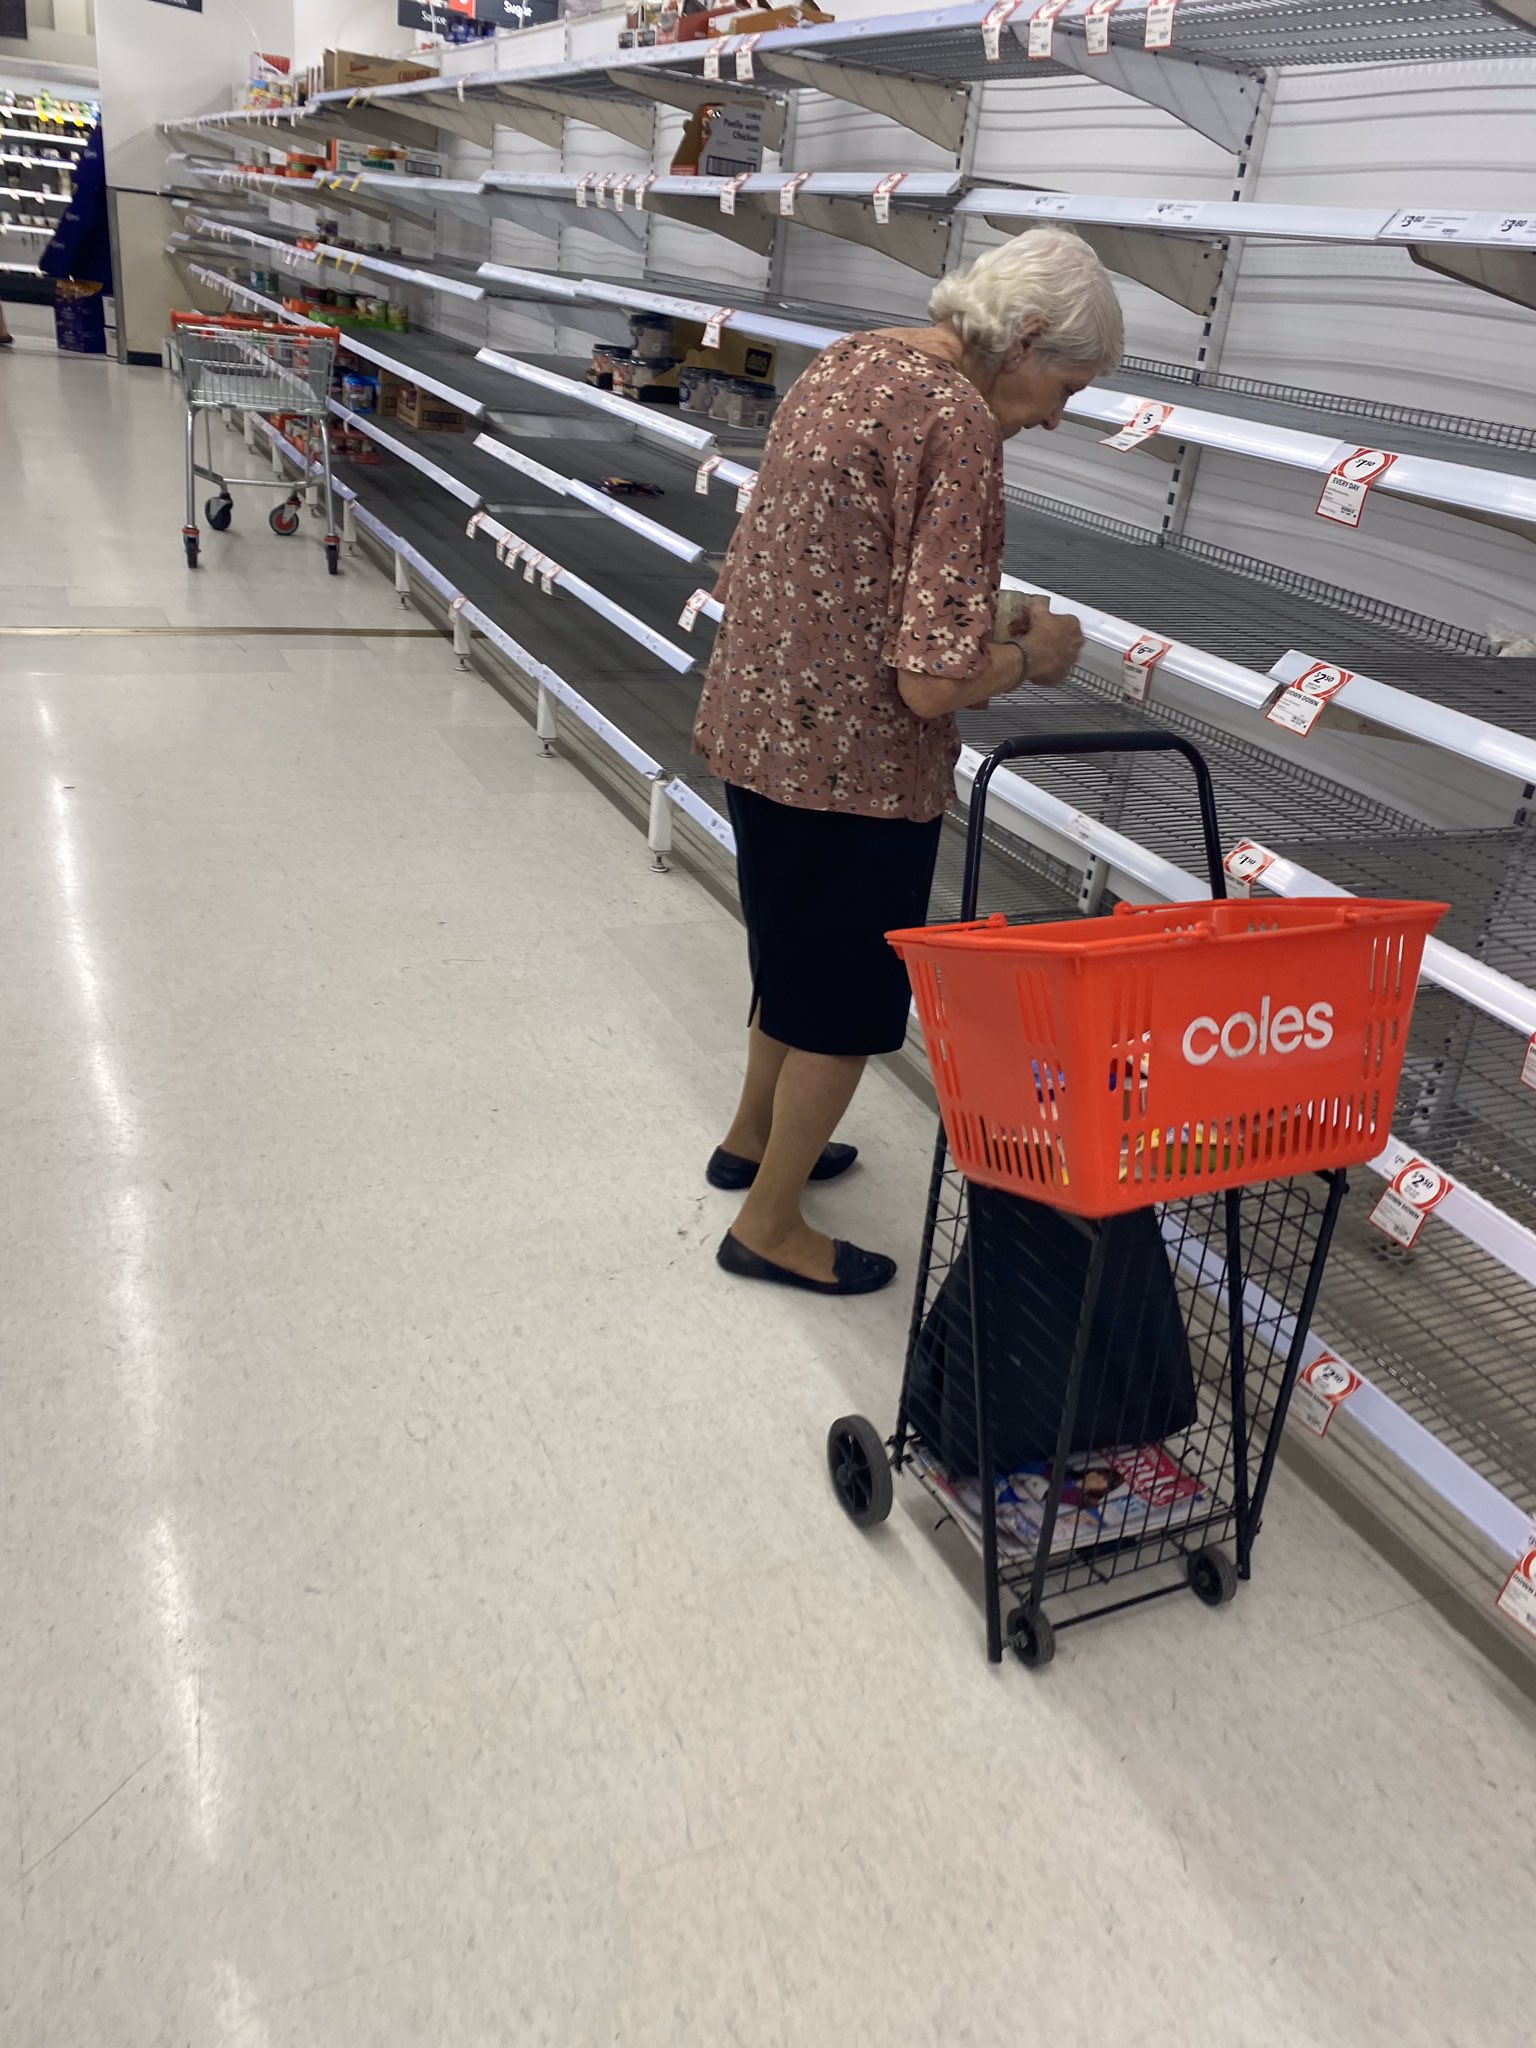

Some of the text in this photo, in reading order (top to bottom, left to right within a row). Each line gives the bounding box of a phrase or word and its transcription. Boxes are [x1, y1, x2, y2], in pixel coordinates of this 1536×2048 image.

[732, 131, 759, 143] Chicken
[1333, 477, 1361, 492] EVERY DAY
[1286, 689, 1302, 701] DOWN
[1301, 695, 1320, 707] DOWN
[1182, 995, 1334, 1066] coles
